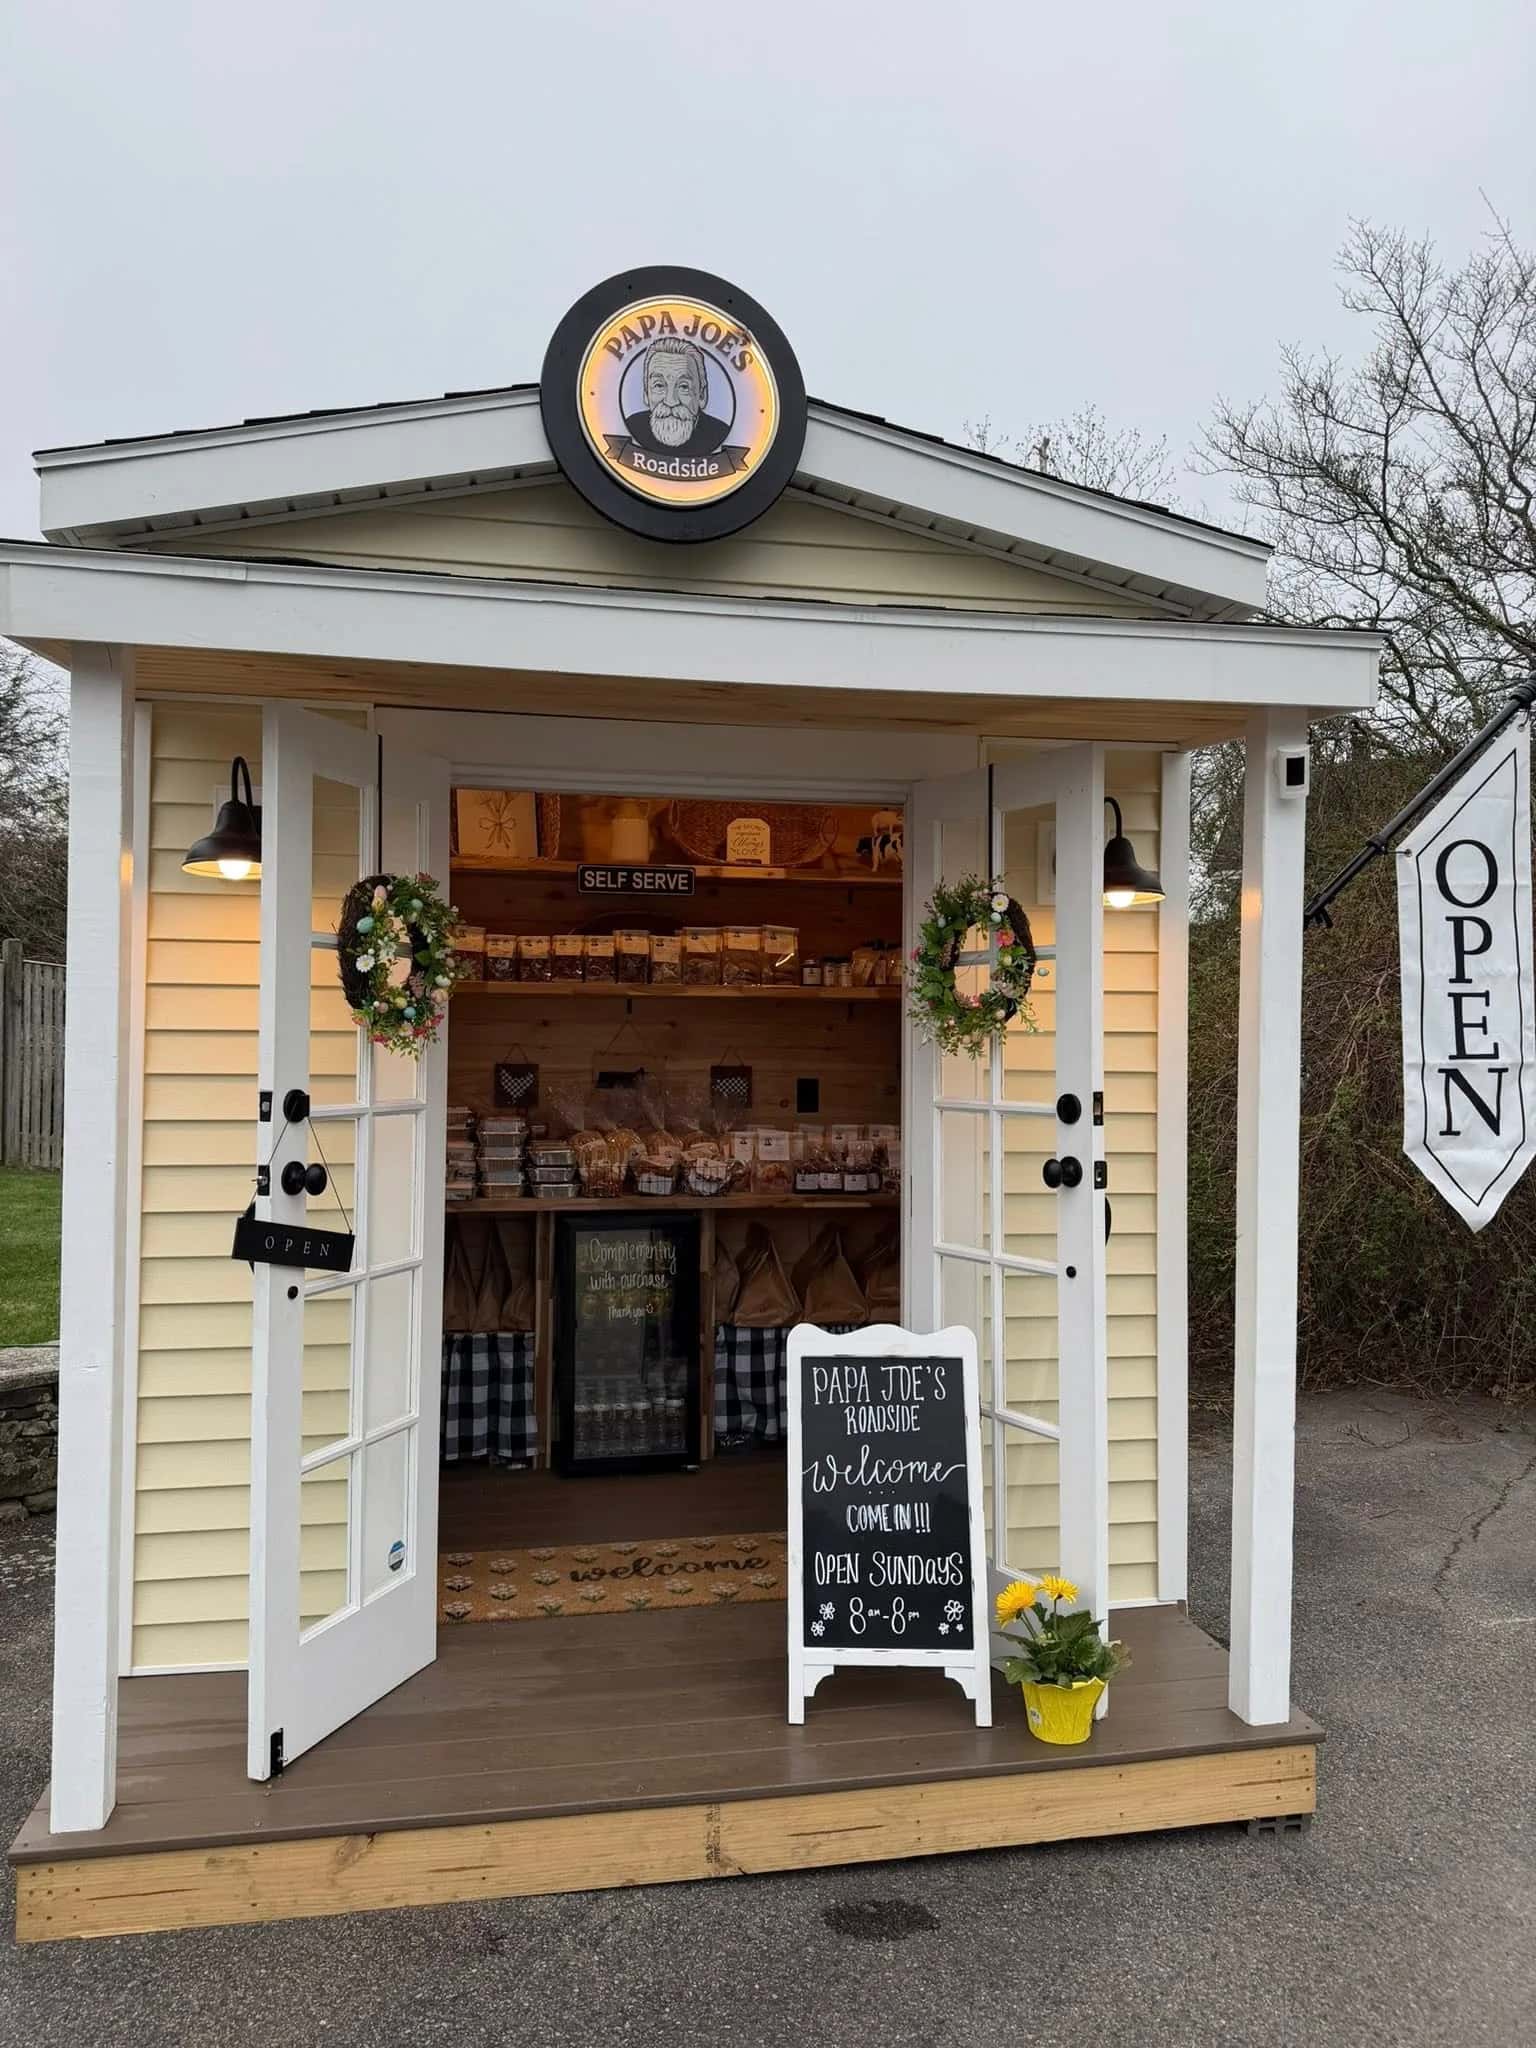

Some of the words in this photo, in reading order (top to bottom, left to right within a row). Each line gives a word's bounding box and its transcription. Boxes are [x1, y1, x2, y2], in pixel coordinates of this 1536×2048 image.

[604, 311, 677, 362] PAPA
[683, 314, 754, 372] JOE'S
[633, 452, 719, 478] Roadside
[584, 871, 628, 889] SELF
[632, 872, 689, 890] SERVE
[1435, 838, 1509, 1137] OPEN
[264, 1235, 330, 1257] OPEN
[590, 1270, 616, 1290] with
[620, 1271, 668, 1297] purchase
[812, 1365, 871, 1405] PAPA
[880, 1365, 946, 1401] JOE'S
[844, 1404, 921, 1435] ROADSIDE
[846, 1503, 893, 1533] COME
[569, 1556, 769, 1583] welcome
[815, 1551, 860, 1585] OPEN
